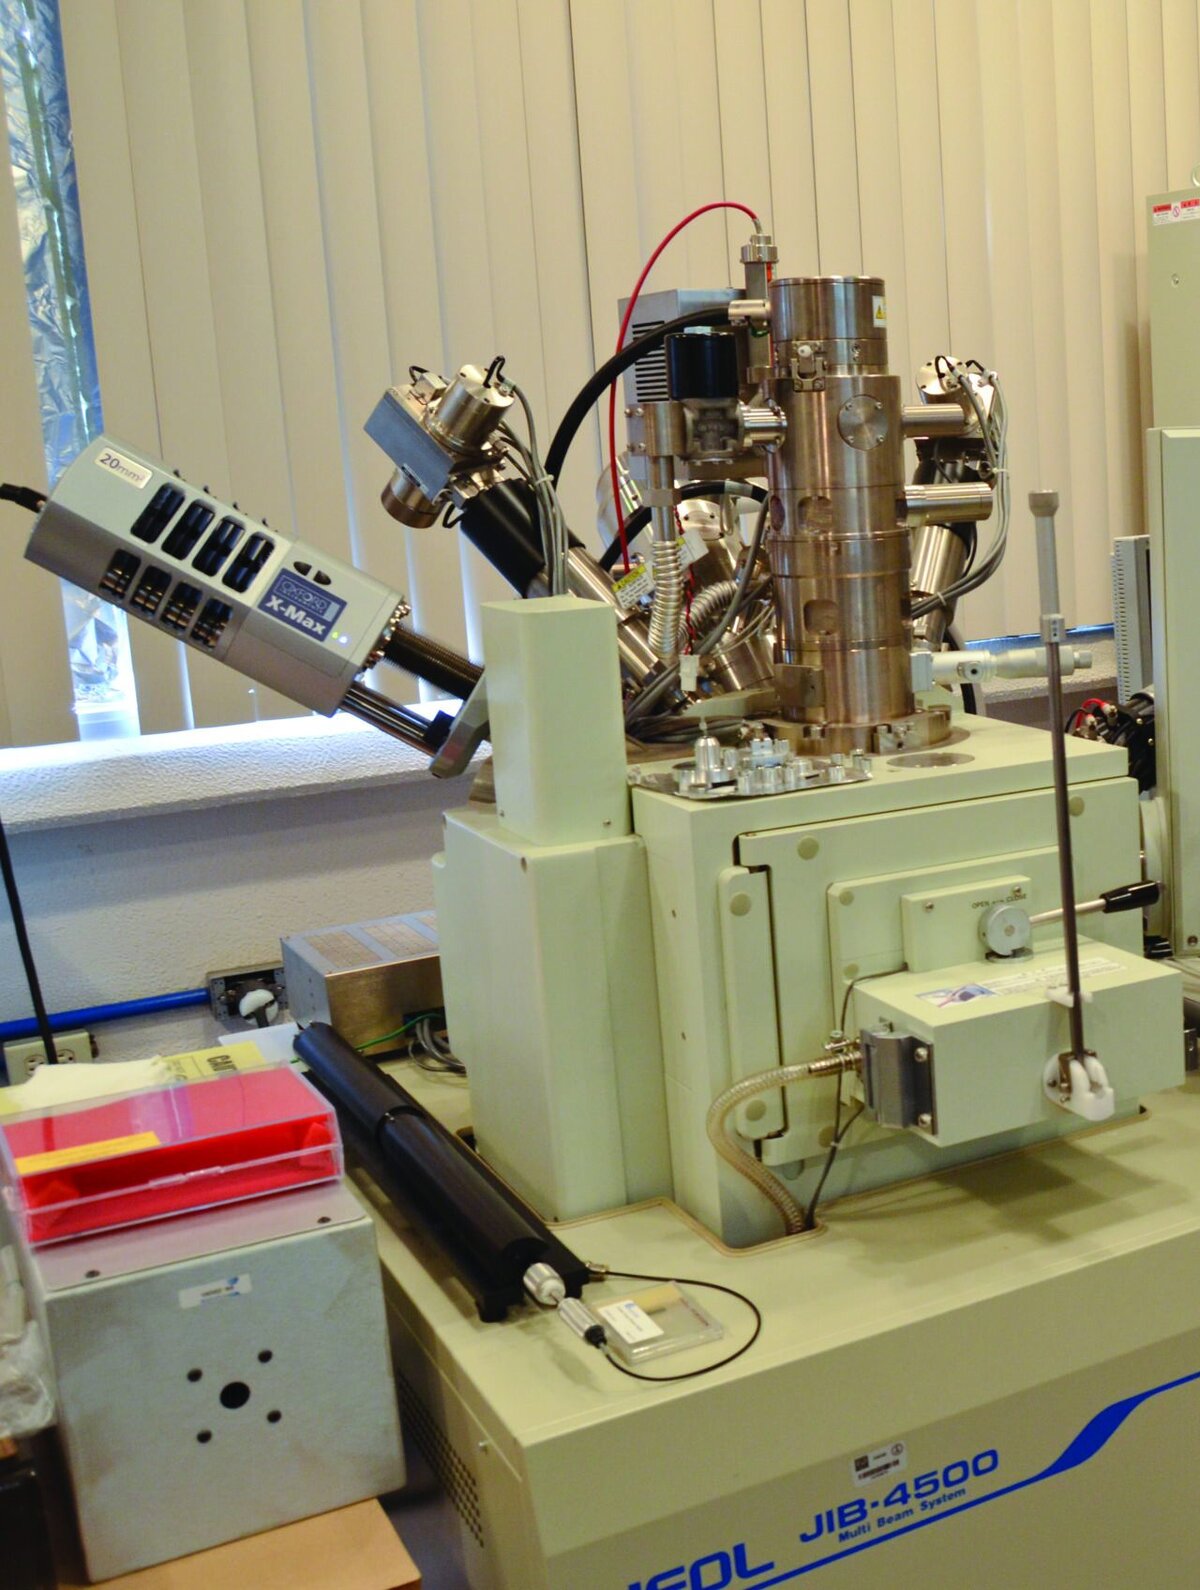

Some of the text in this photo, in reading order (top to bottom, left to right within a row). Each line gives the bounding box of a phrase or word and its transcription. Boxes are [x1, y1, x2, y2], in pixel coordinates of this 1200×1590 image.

[264, 594, 327, 635] X-Max
[799, 1448, 1000, 1543] JIB-4500
[837, 1488, 967, 1544] Multi Beam System
[627, 1543, 776, 1590] EOL
